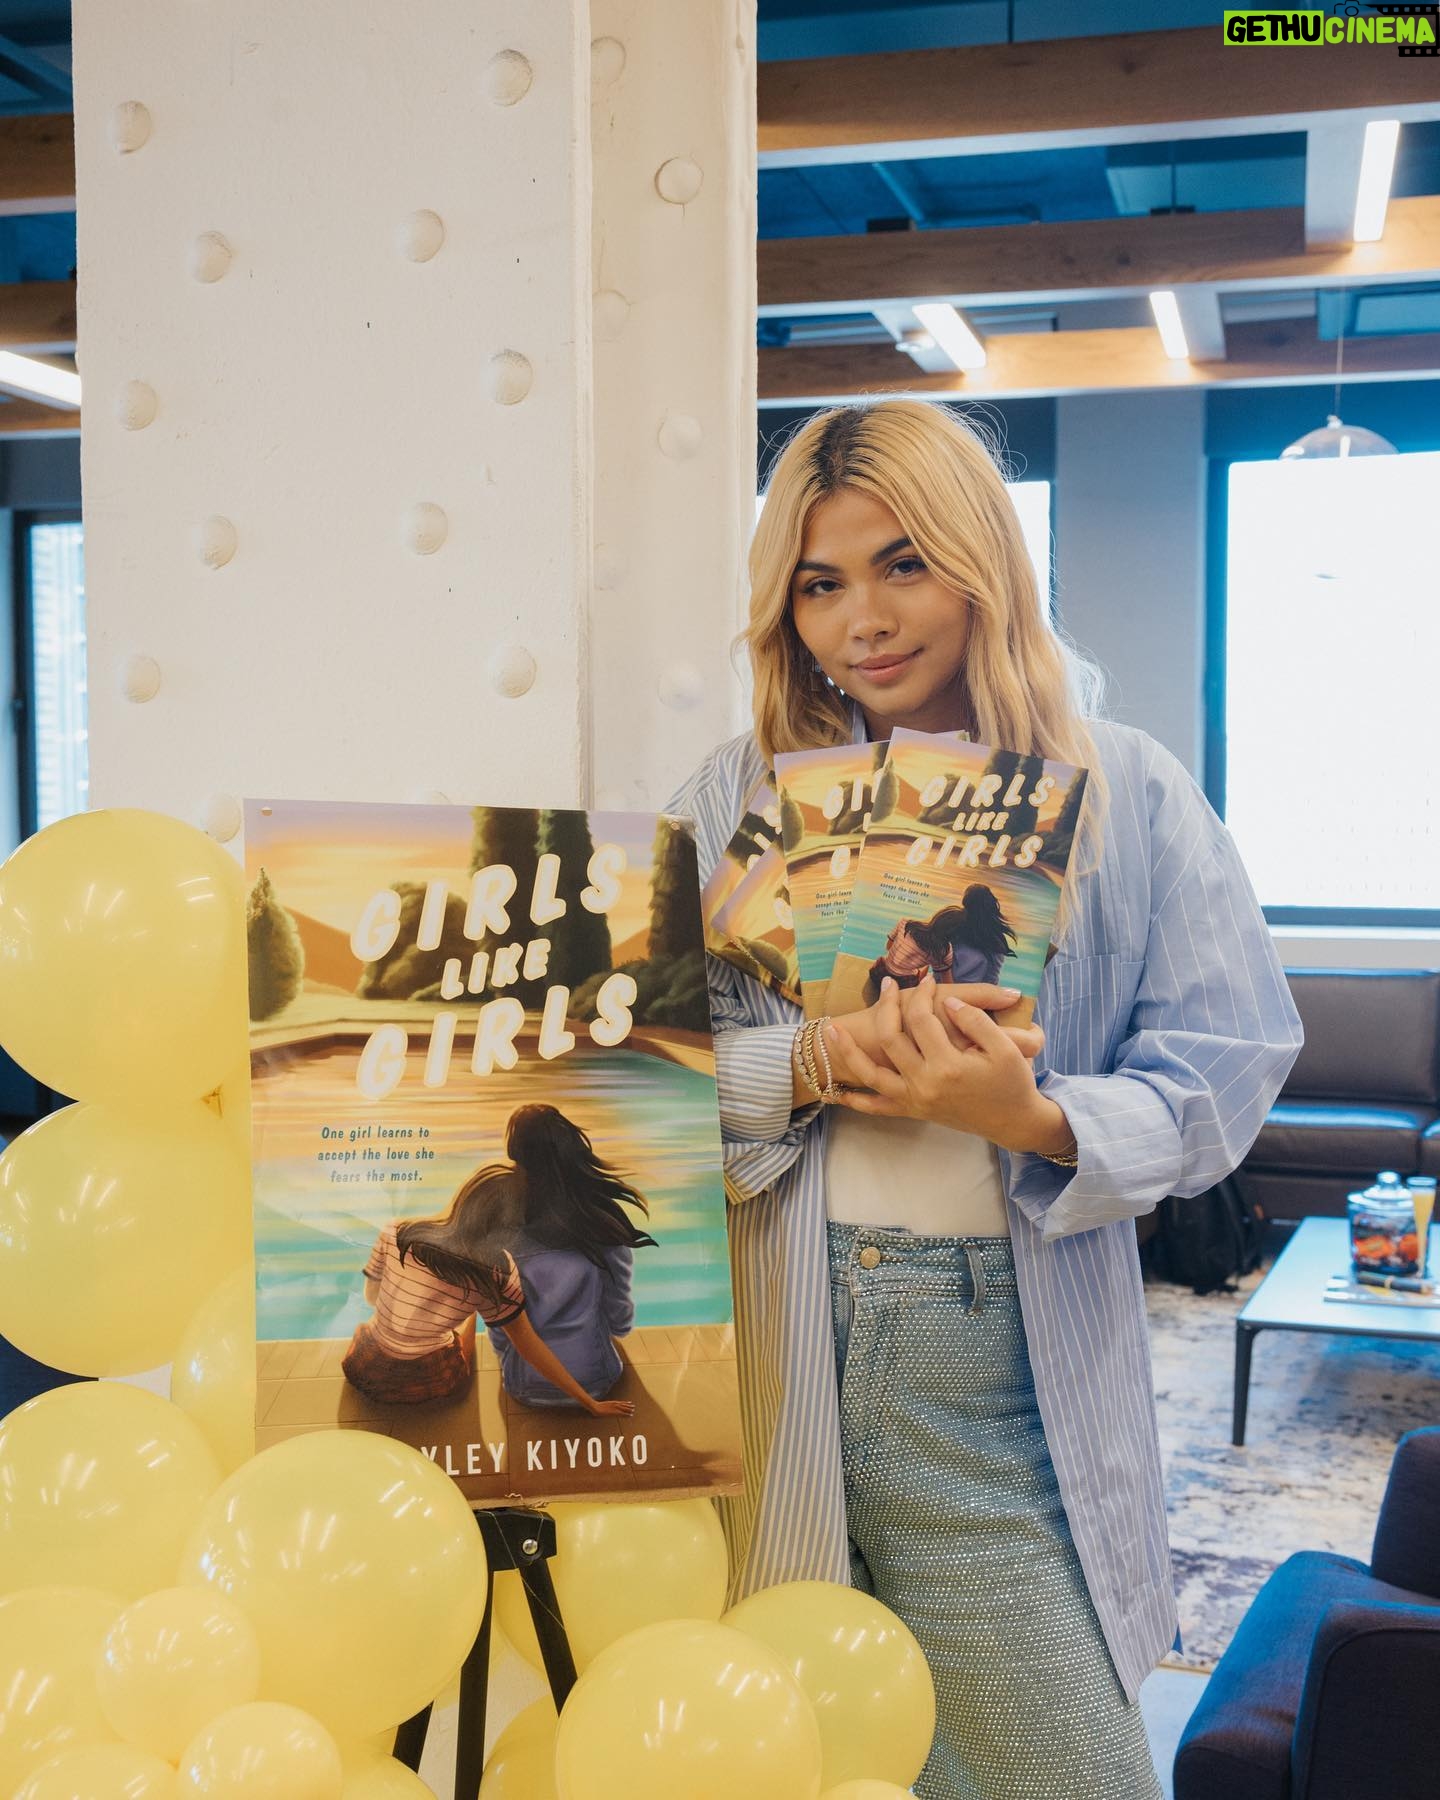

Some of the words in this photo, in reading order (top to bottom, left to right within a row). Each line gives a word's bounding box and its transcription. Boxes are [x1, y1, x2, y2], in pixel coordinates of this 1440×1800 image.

[919, 773, 1056, 808] GIRLS
[952, 811, 1010, 832] LIKE
[905, 834, 1044, 868] GIRLS
[350, 842, 627, 962] GIRLS
[440, 938, 552, 1000] LIKE
[356, 972, 638, 1099] GIRLS
[322, 1126, 344, 1139] One
[349, 1126, 371, 1142] girl
[377, 1126, 413, 1138] learns
[419, 1127, 430, 1138] to
[317, 1149, 357, 1164] accept
[362, 1148, 381, 1160] the
[387, 1147, 410, 1159] love
[415, 1147, 435, 1160] she
[330, 1170, 361, 1182] fears
[366, 1169, 385, 1181] the
[390, 1170, 423, 1181] most.
[527, 1434, 649, 1471] KIYOKO
